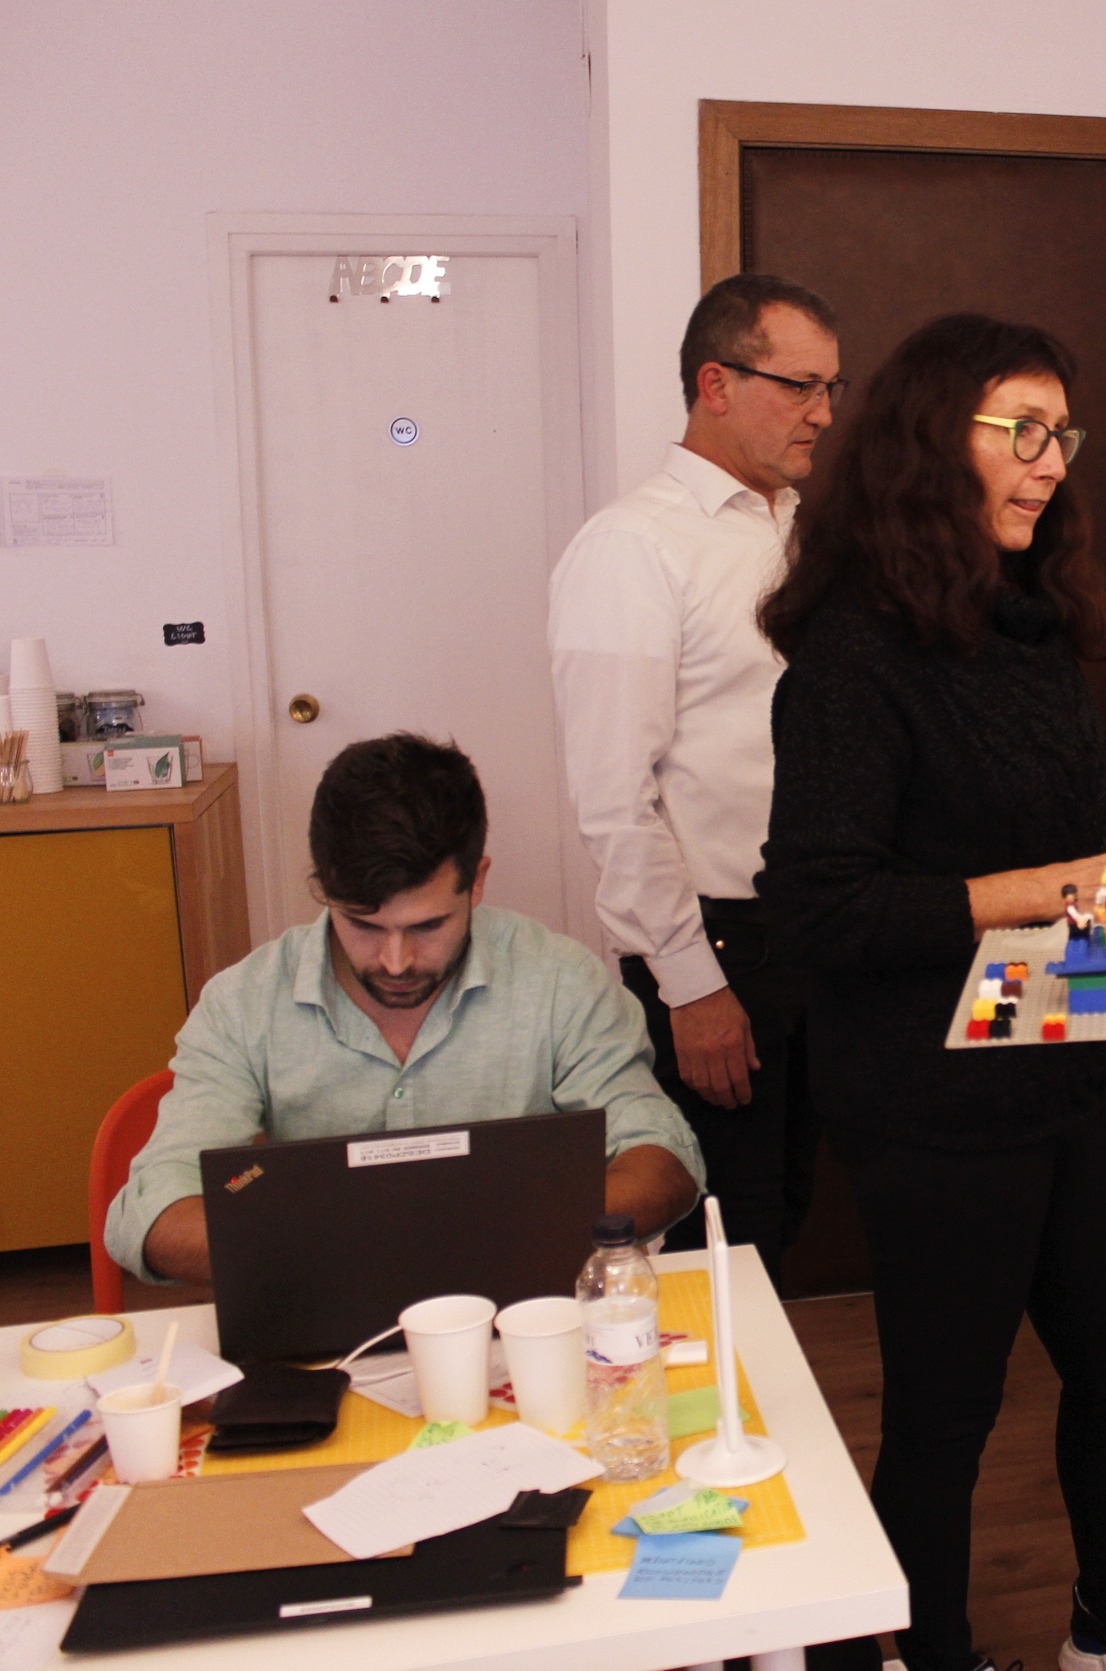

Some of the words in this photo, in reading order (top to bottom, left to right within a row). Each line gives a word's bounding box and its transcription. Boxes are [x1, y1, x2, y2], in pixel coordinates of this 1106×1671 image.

[328, 255, 450, 296] ABCDE
[395, 426, 413, 435] WC
[223, 1164, 265, 1195] ThinkPad
